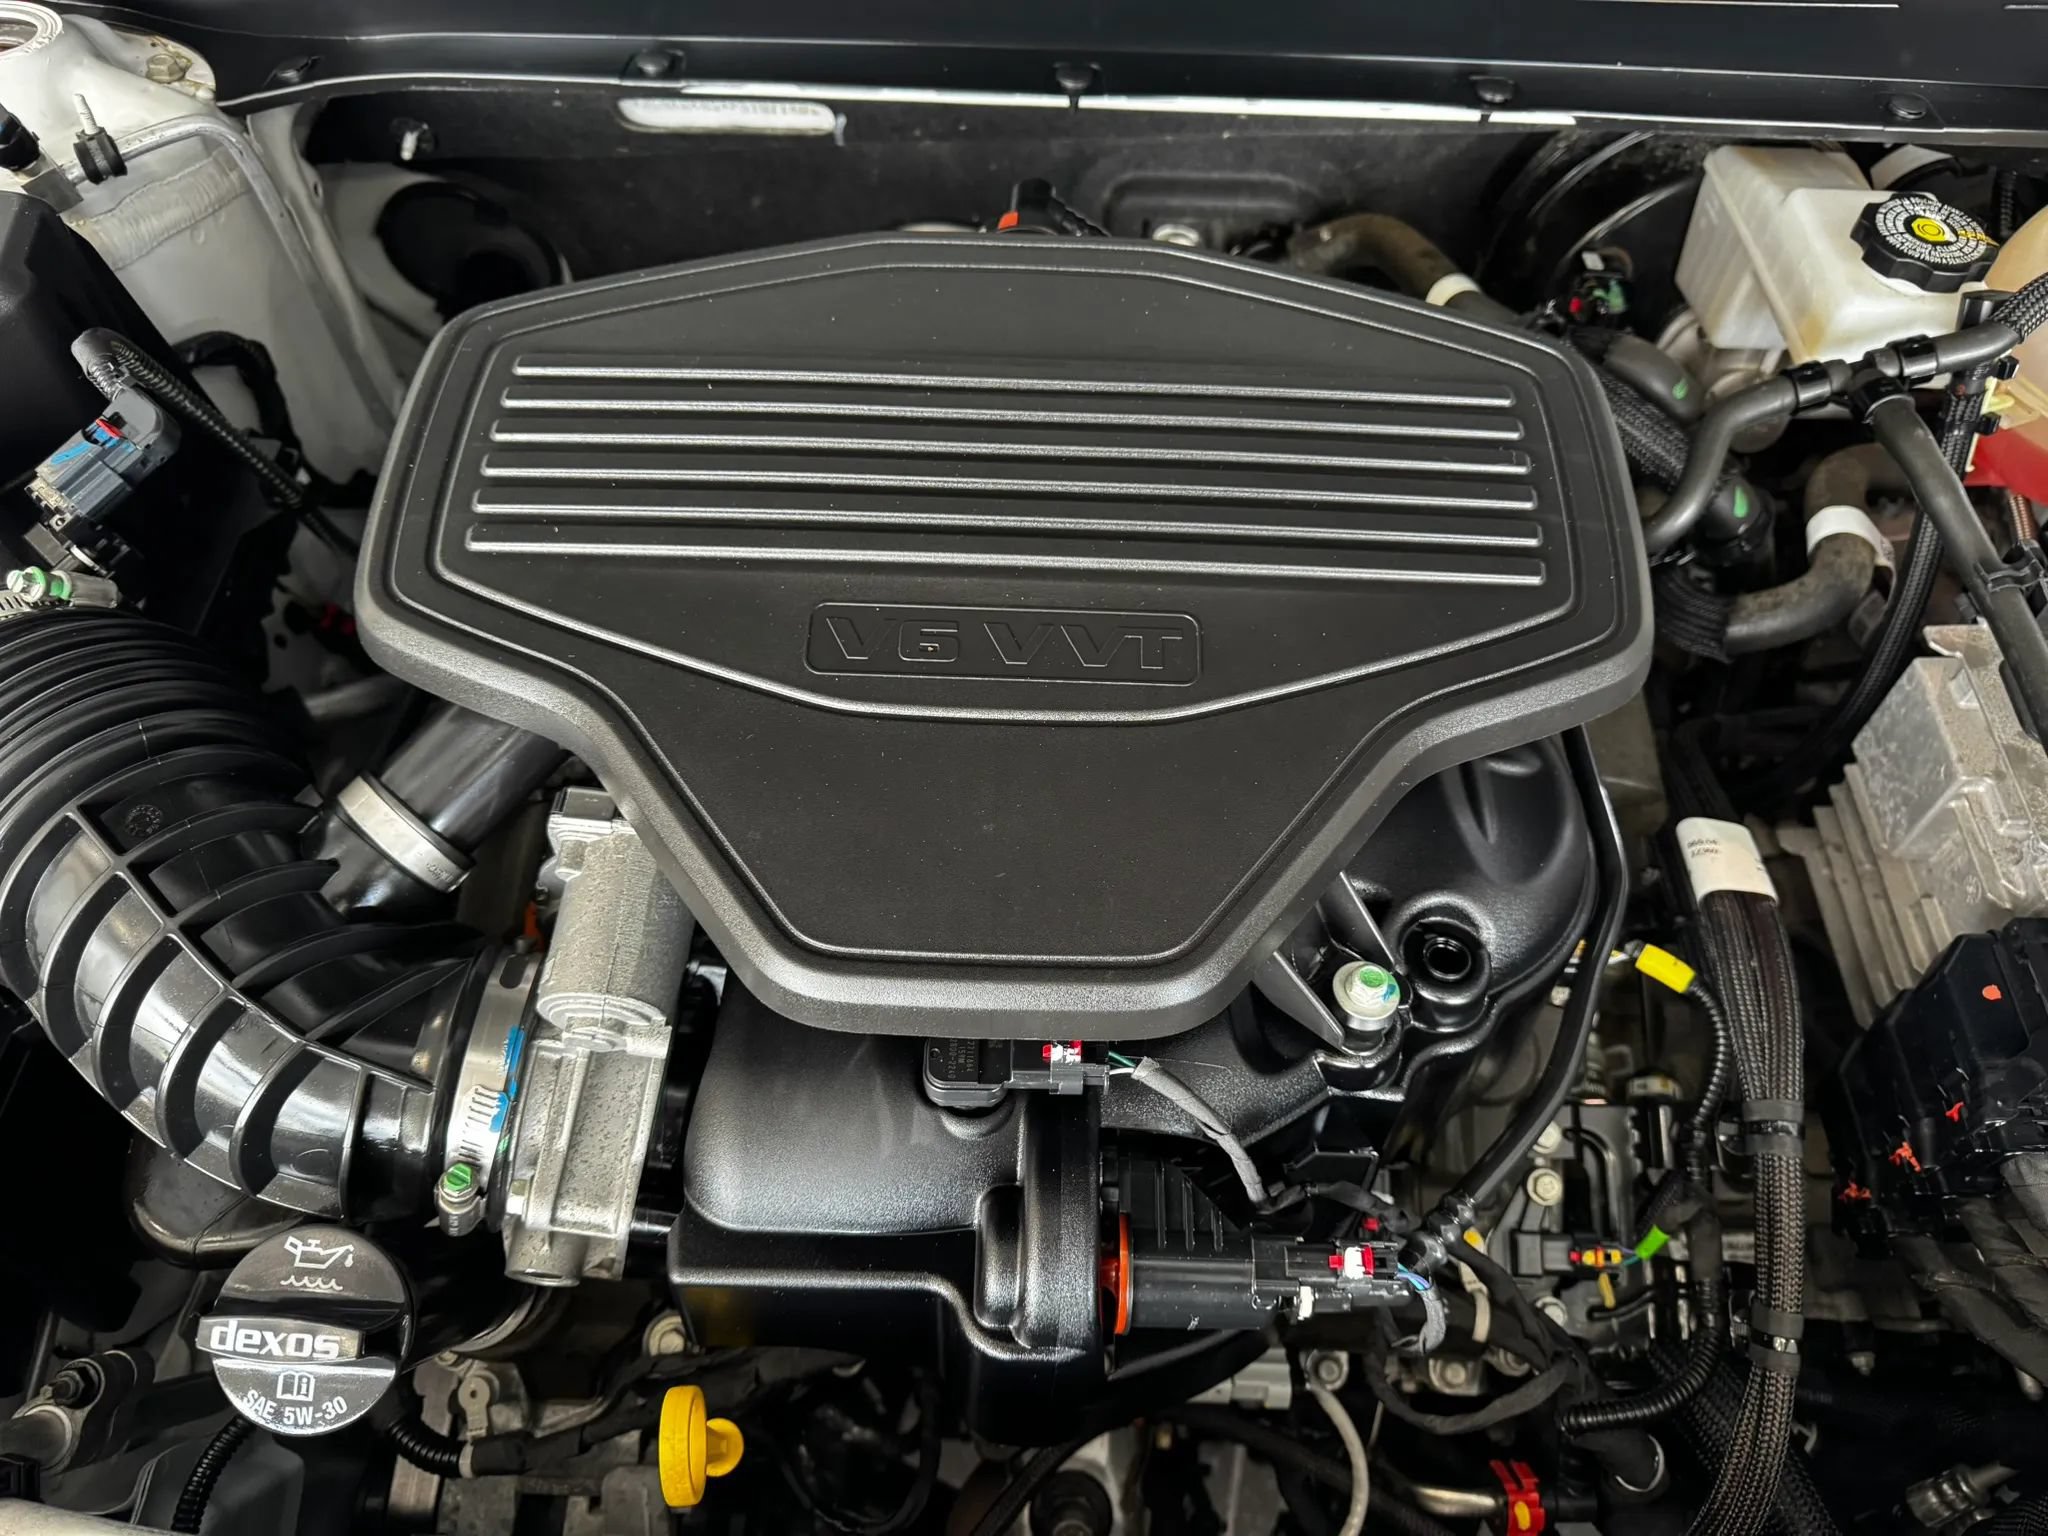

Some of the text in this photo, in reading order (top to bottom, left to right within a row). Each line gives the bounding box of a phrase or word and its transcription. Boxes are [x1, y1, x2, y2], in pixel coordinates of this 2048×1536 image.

[826, 617, 1184, 669] V6 VVT
[210, 1319, 341, 1359] dexos
[243, 1389, 348, 1426] SAE 5W-30
